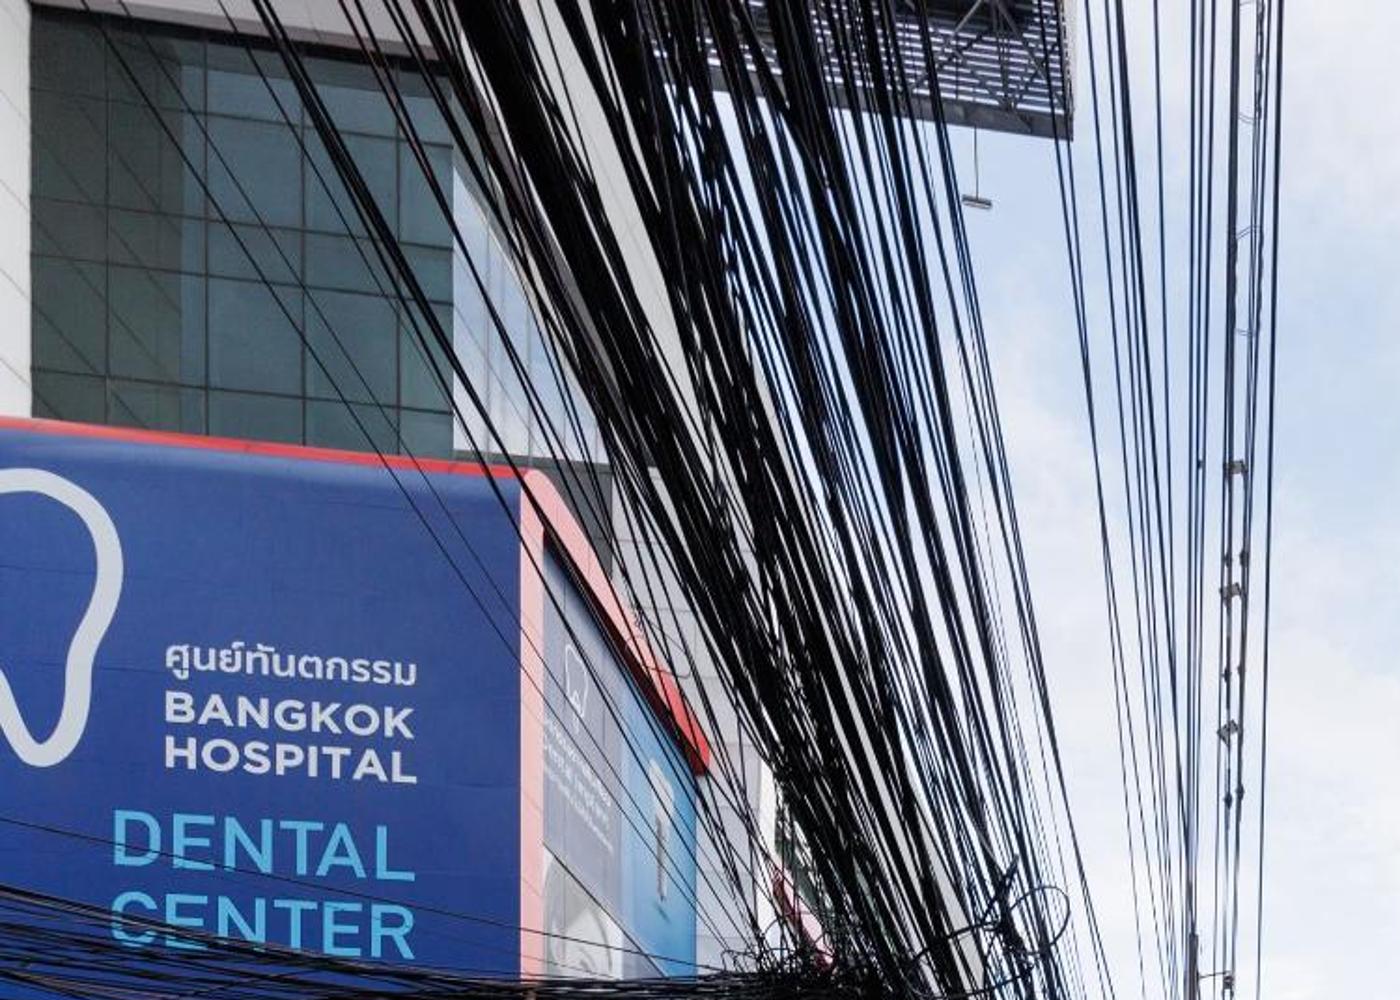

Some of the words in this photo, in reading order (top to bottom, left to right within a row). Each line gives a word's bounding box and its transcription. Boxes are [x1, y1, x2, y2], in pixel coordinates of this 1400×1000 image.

[165, 641, 418, 687] ศูนย์ทันตกรรม
[165, 690, 415, 740] BANGKOK
[165, 735, 418, 784] HOSPITAL
[113, 809, 416, 882] DENTAL
[110, 891, 416, 960] CENTER
